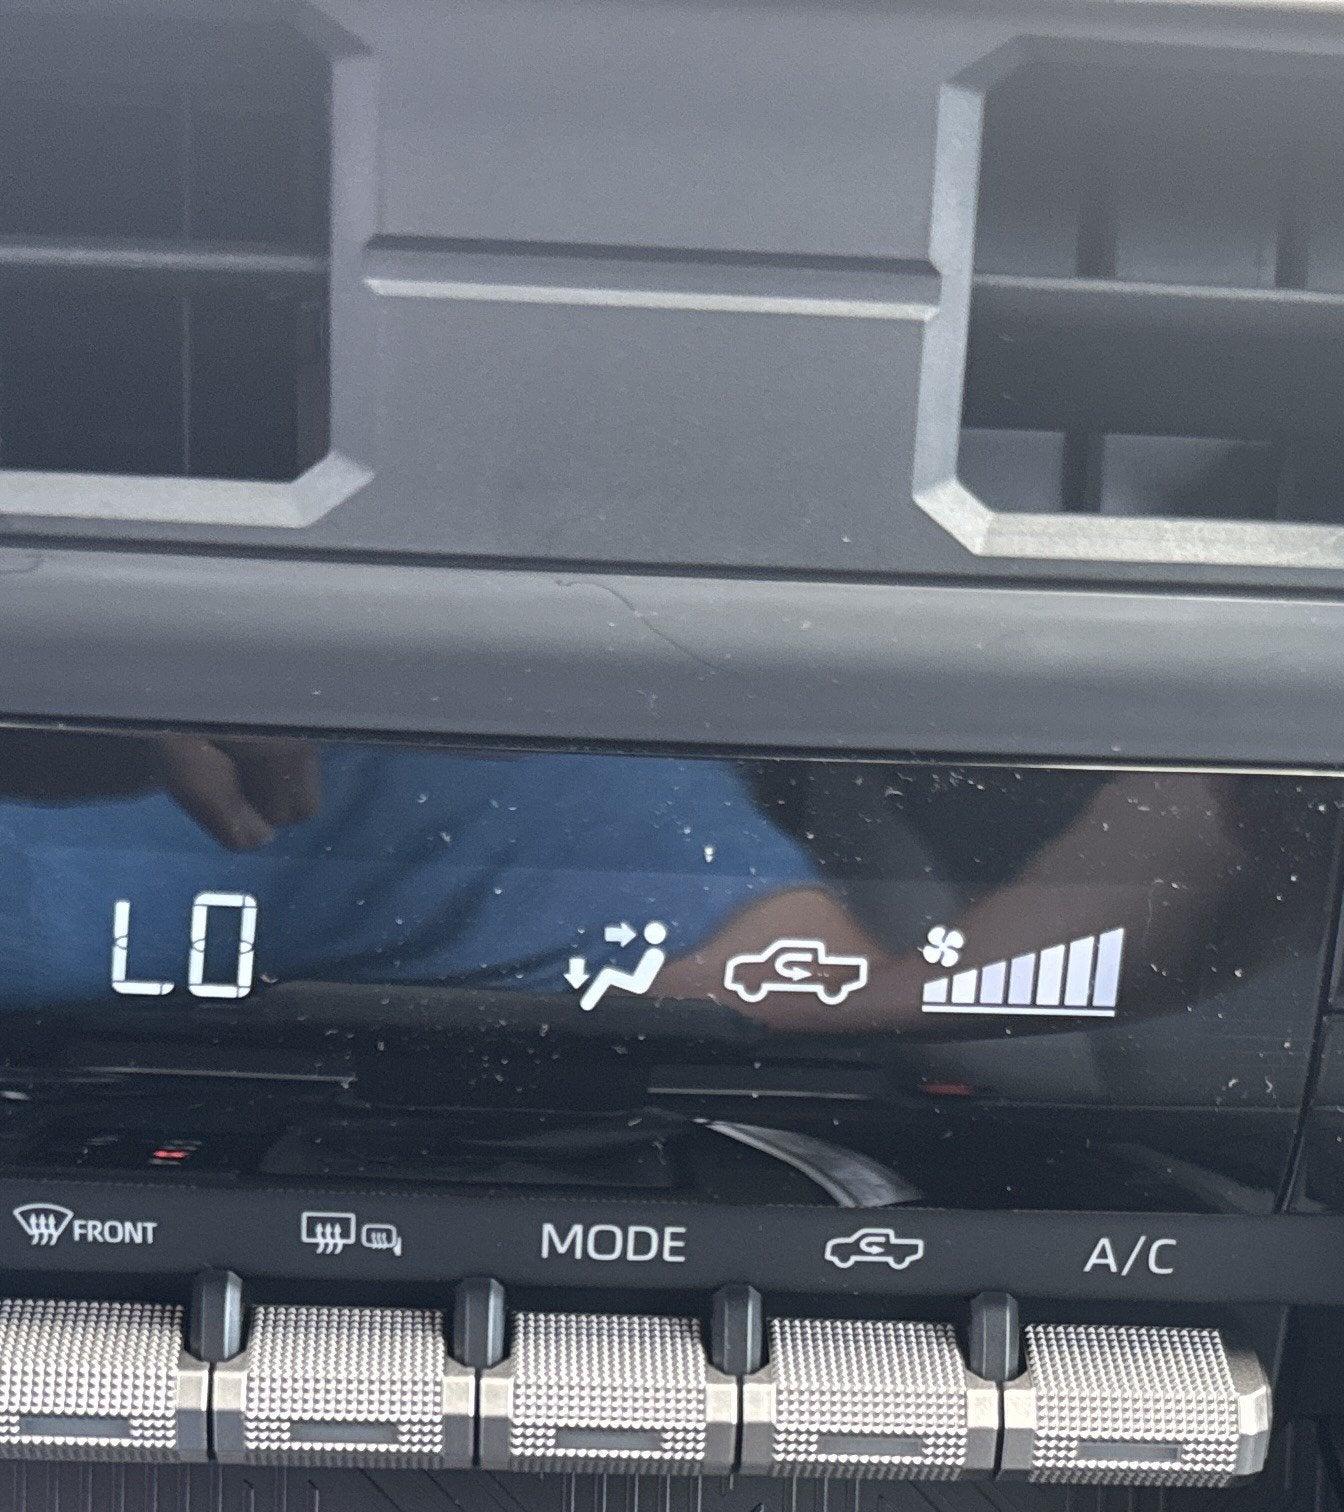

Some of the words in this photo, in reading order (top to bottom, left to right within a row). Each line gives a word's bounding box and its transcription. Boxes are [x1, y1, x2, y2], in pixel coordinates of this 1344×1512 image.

[111, 891, 258, 999] LO
[72, 1219, 158, 1244] FRONT
[541, 1222, 686, 1262] MODE
[1083, 1235, 1177, 1276] A/C
